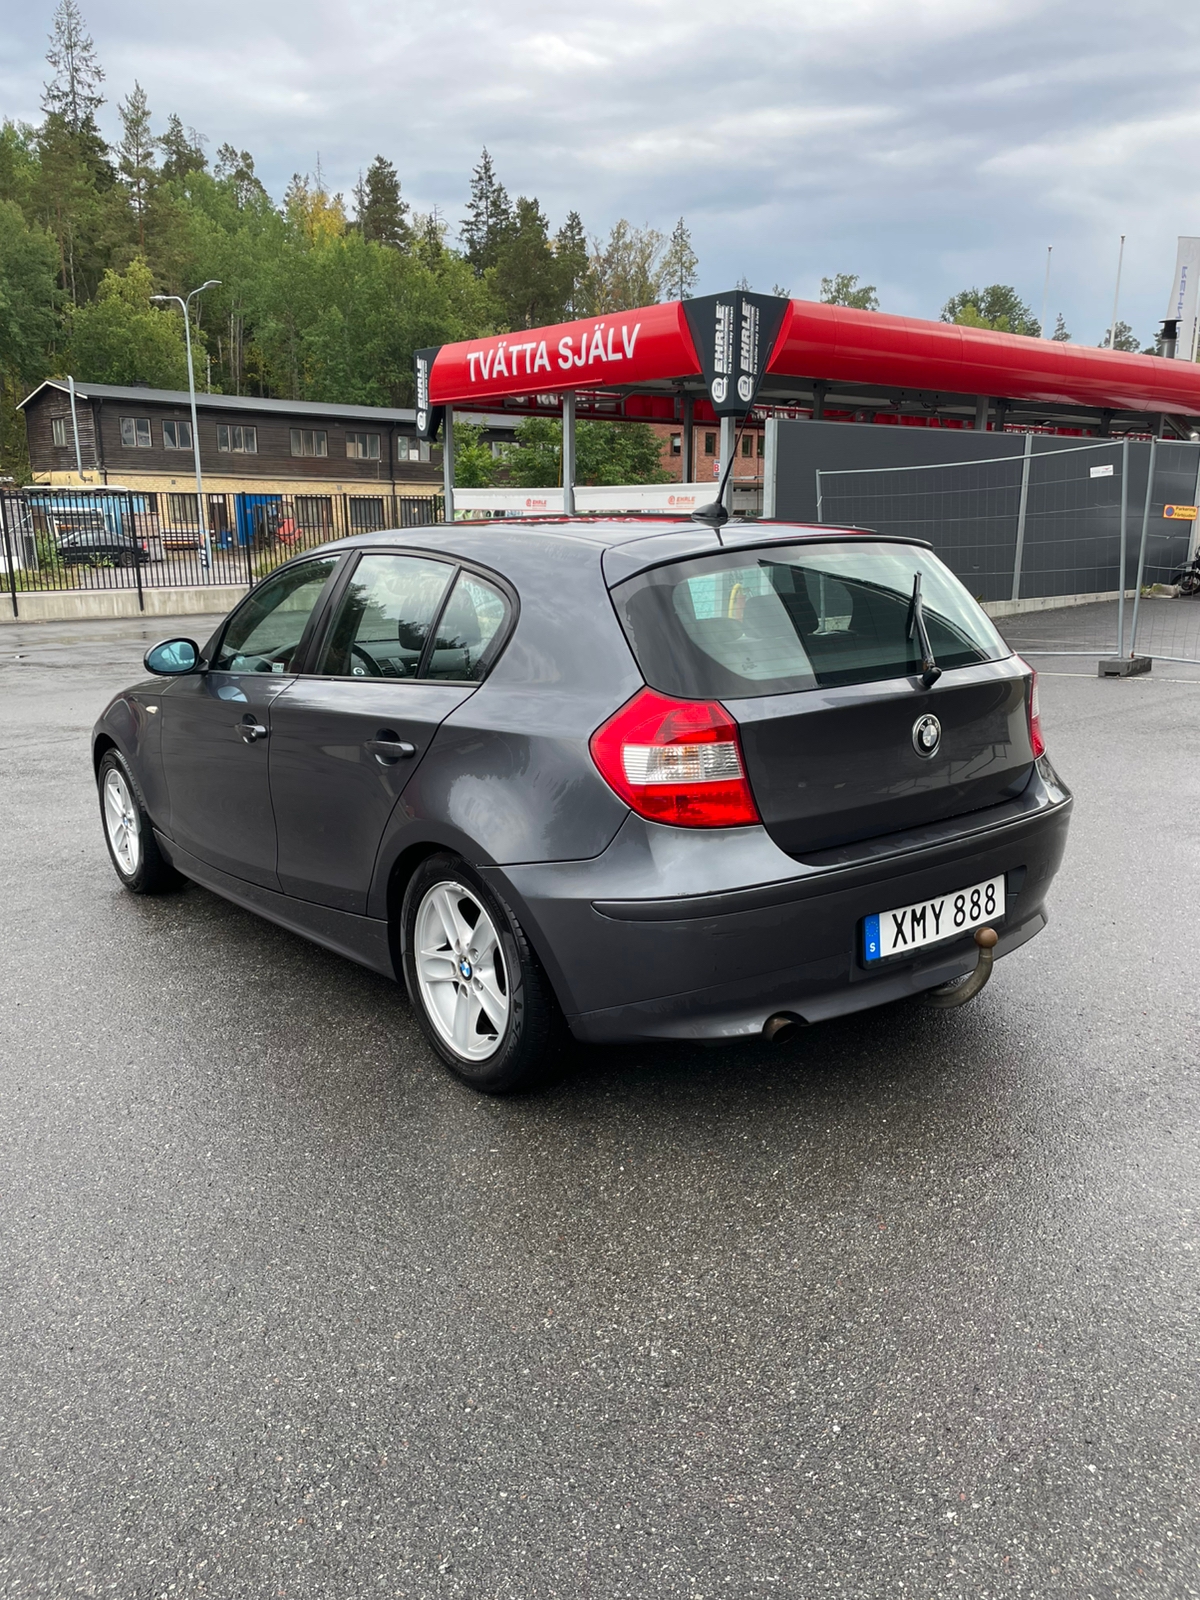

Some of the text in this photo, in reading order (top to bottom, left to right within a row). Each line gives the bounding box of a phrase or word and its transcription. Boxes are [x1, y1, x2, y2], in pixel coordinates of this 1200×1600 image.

[467, 323, 641, 382] TVÄTTA SJÄLV
[714, 303, 726, 373] EHRLE
[740, 301, 751, 373] EHRLE
[869, 942, 876, 953] S
[891, 883, 996, 949] XMY 888
